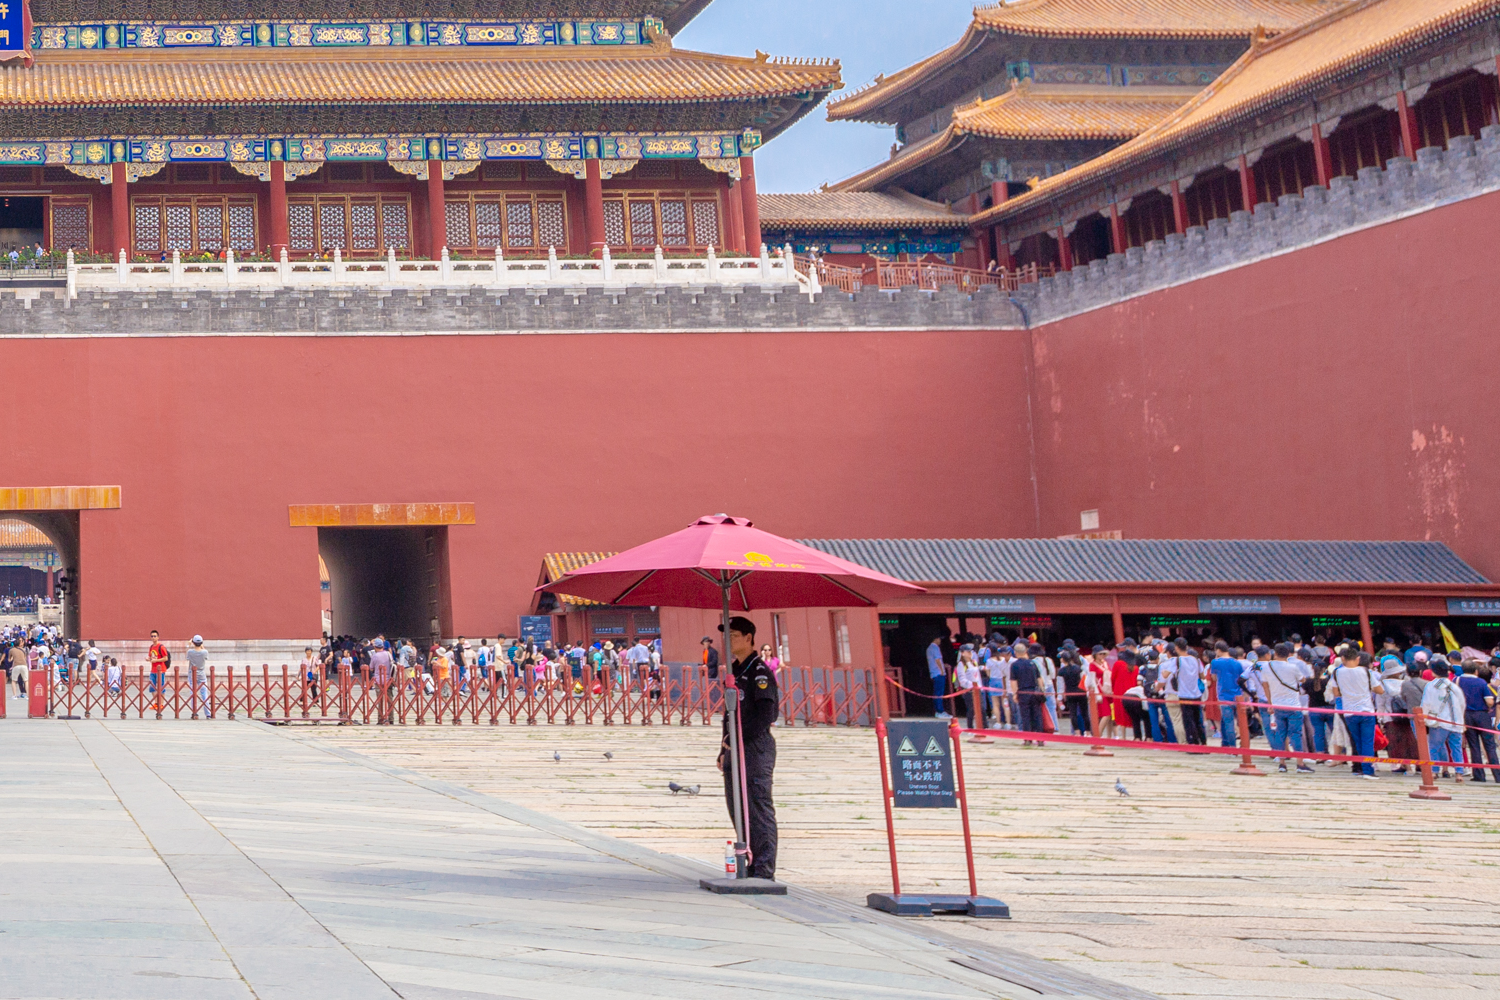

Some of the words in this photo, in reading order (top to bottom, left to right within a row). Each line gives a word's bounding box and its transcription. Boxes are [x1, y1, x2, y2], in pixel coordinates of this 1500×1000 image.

[902, 759, 942, 770] 路面不平
[904, 771, 942, 781] 当心跌滑
